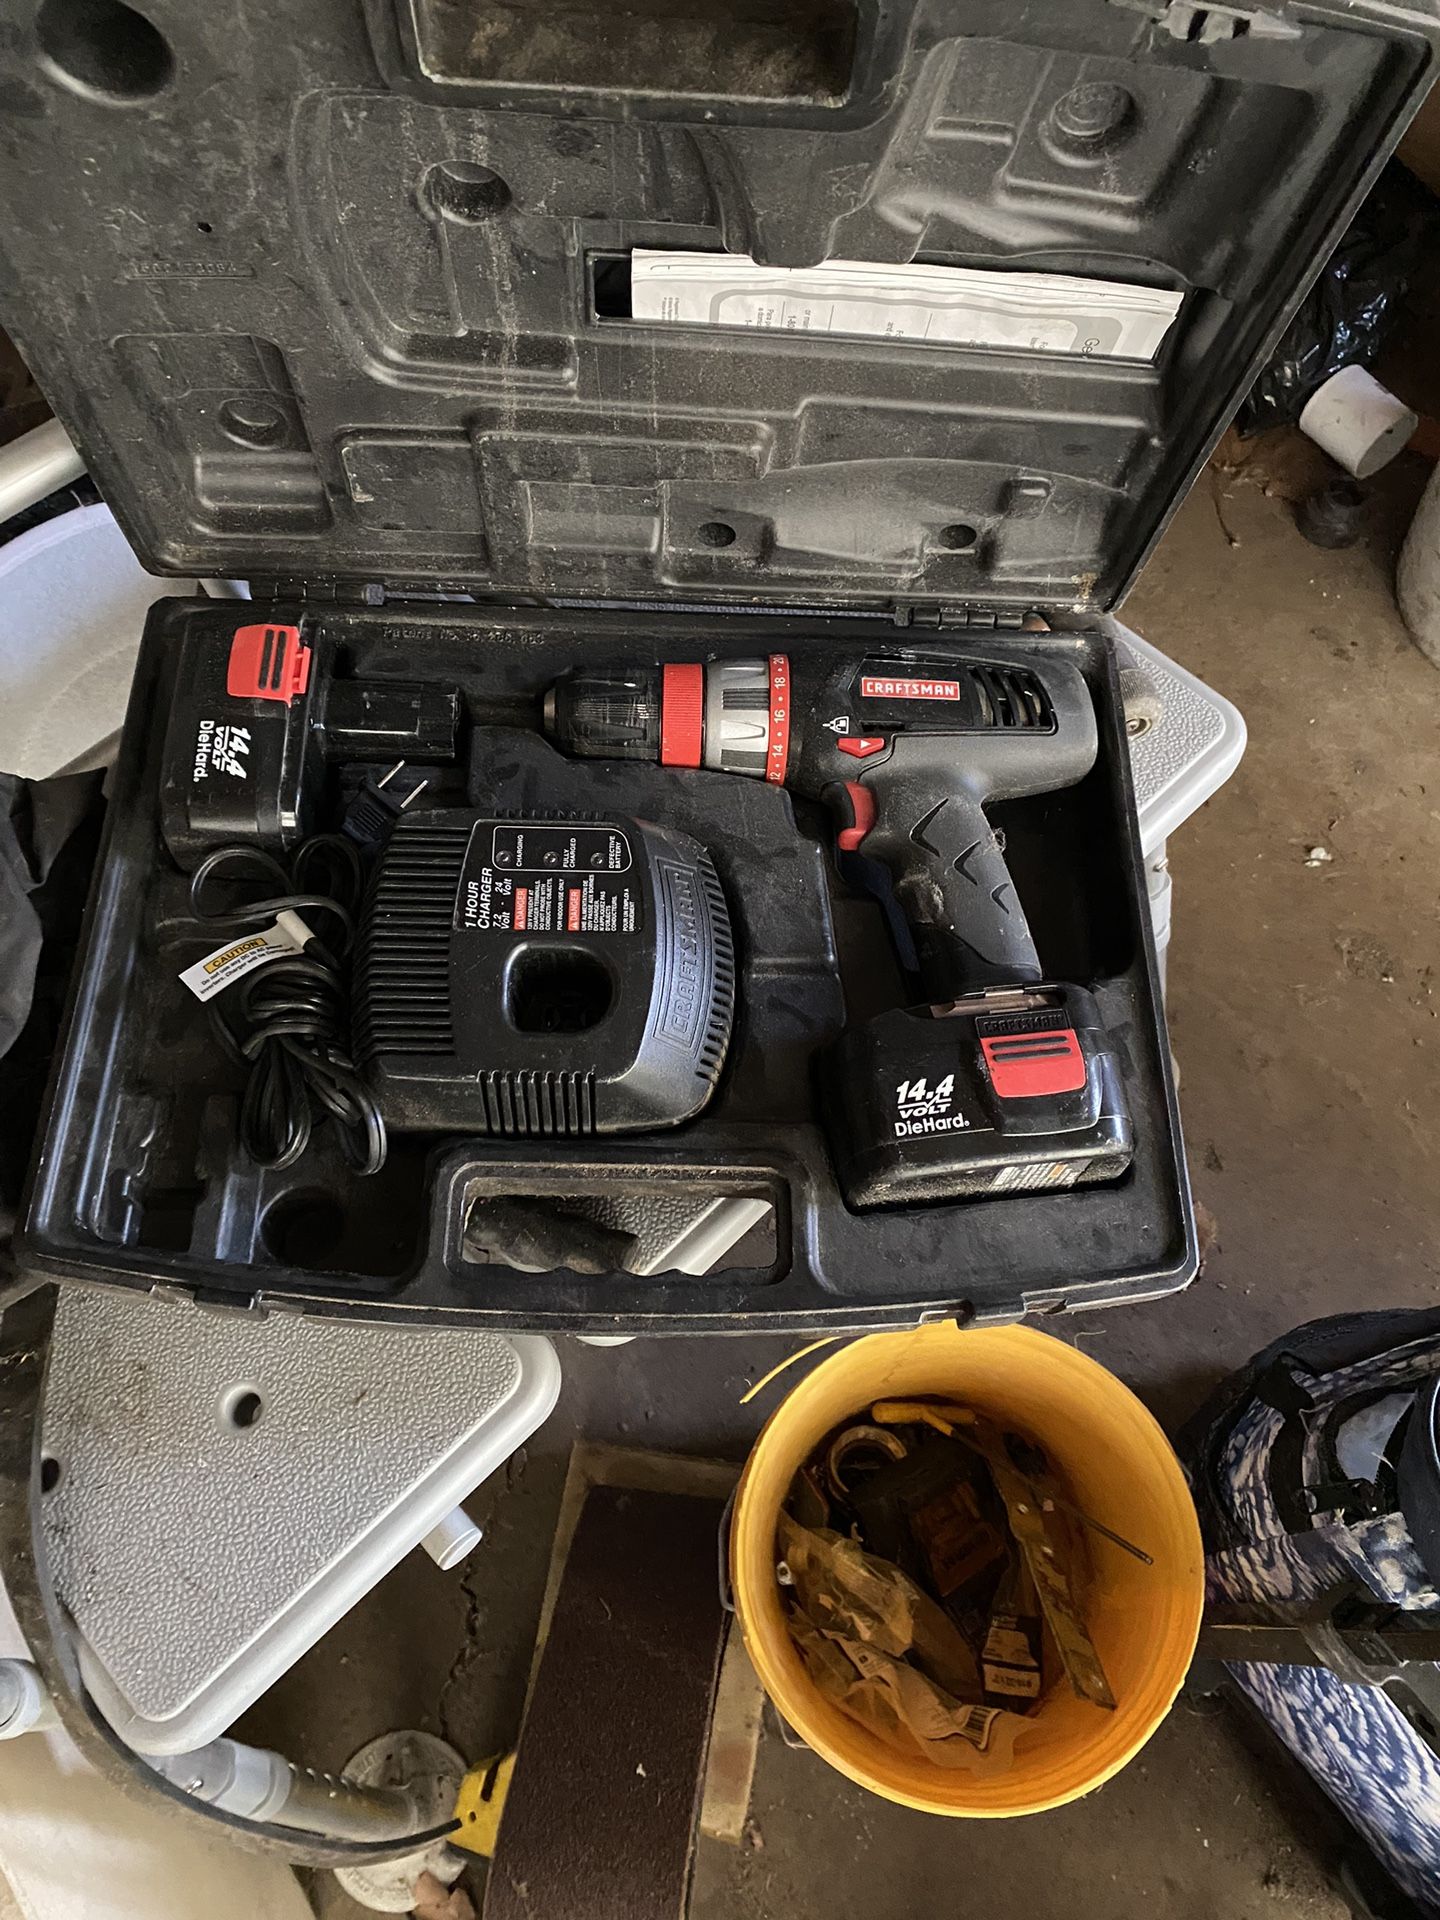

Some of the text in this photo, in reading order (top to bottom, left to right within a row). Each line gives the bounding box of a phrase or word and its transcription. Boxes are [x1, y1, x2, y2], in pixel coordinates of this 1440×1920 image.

[774, 676, 786, 690] 18
[866, 682, 955, 696] CRAFTSMAN
[774, 709, 786, 724] 16
[211, 725, 225, 770] VOLT
[226, 725, 252, 779] 14.4
[772, 744, 784, 758] 14
[516, 834, 524, 867] CHARGING
[569, 837, 577, 868] CHARGED
[608, 835, 616, 869] DEFECTIVE
[465, 881, 479, 919] HOUR
[477, 867, 493, 929] CHARGER
[495, 881, 504, 893] 24
[501, 878, 512, 929] Volt Volt
[516, 890, 525, 920] DANGER
[570, 891, 578, 920] DANGER
[493, 913, 502, 927] 7.2
[539, 923, 544, 931] DO
[212, 940, 260, 968] CAUTION
[896, 1074, 955, 1104] 14.4
[899, 1103, 951, 1119] VOLT
